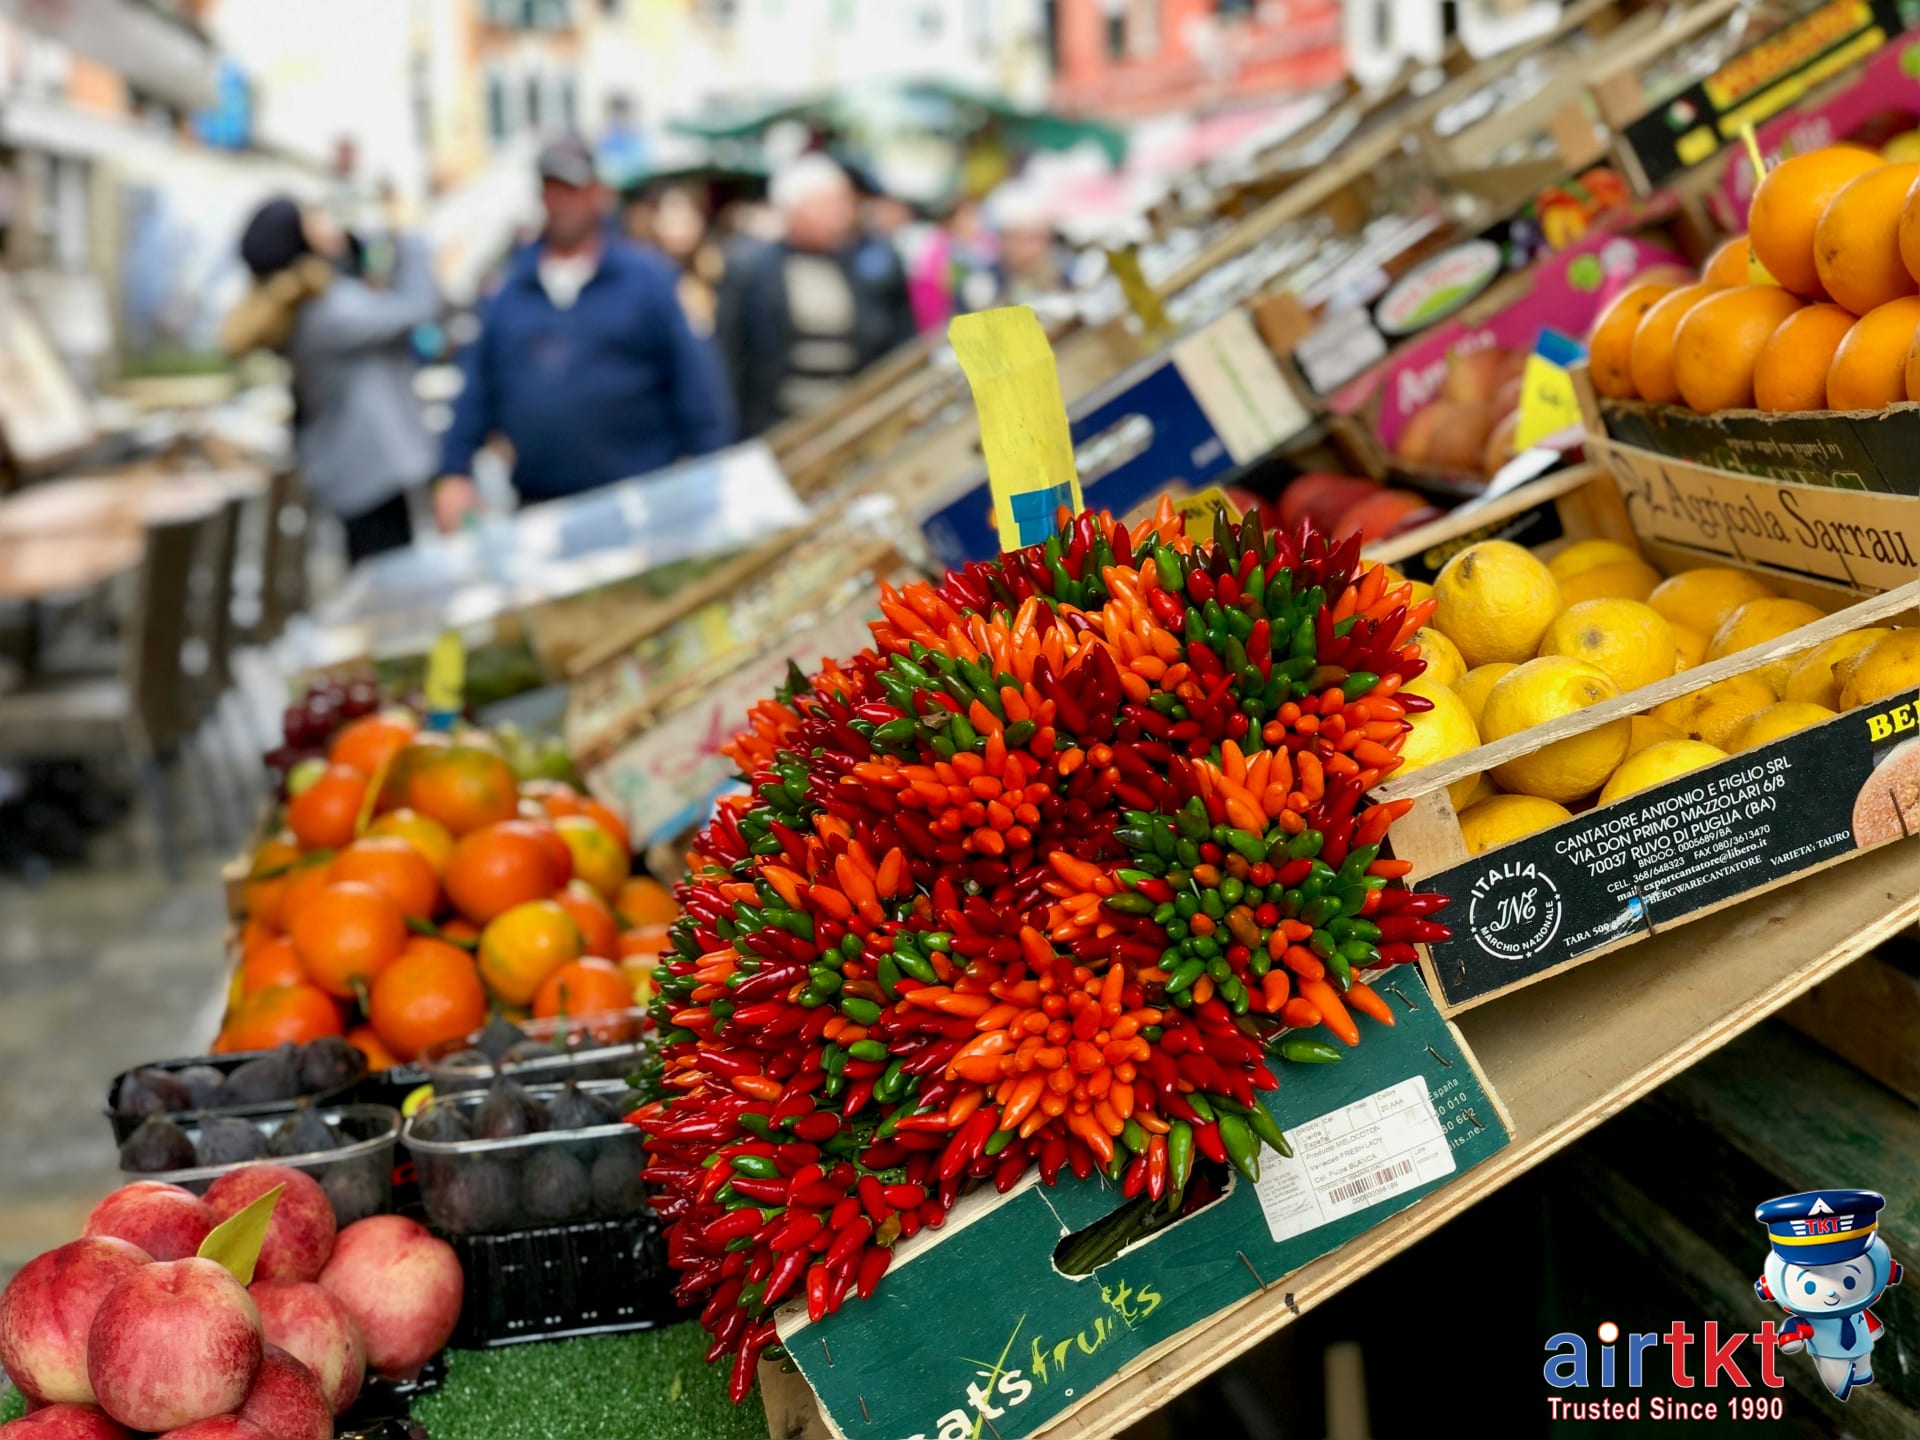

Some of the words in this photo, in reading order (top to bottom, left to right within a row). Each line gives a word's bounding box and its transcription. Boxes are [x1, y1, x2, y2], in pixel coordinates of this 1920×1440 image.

[1778, 489, 1918, 567] Sarrau
[1866, 700, 1920, 742] BE
[1555, 812, 1639, 854] CANTATORE
[1641, 788, 1704, 822] ANTONIO
[1707, 784, 1718, 796] E
[1719, 766, 1764, 792] FIGLIO
[1766, 756, 1792, 777] SRL
[1568, 848, 1595, 867] VIA
[1596, 832, 1631, 855] DON
[1634, 816, 1678, 843] PRIMO
[1681, 785, 1761, 826] MAZZOLARI
[1763, 774, 1785, 793] 6/8
[1587, 852, 1627, 877] 70037
[1630, 834, 1670, 860] RUVO
[1673, 828, 1689, 843] DI
[1692, 811, 1741, 838] PUGLIA
[1744, 796, 1777, 820] (BA)
[1606, 879, 1630, 893] CELL.
[1633, 857, 1685, 883] 368/648323
[1694, 846, 1712, 860] FAX
[1712, 824, 1771, 853] 080/3613470
[1638, 848, 1677, 869] BNDOO:
[1678, 827, 1732, 853] 0005689/BA
[1816, 830, 1850, 849] TAURO
[1471, 861, 1536, 899] ITALIA
[1643, 839, 1767, 891] exportcantatore@libero.it
[1480, 926, 1520, 952] MARCHIO
[1522, 900, 1554, 950] NAZIONALE
[1563, 930, 1592, 946] TARA
[1447, 1092, 1467, 1109] 010
[905, 1369, 1032, 1440] ats
